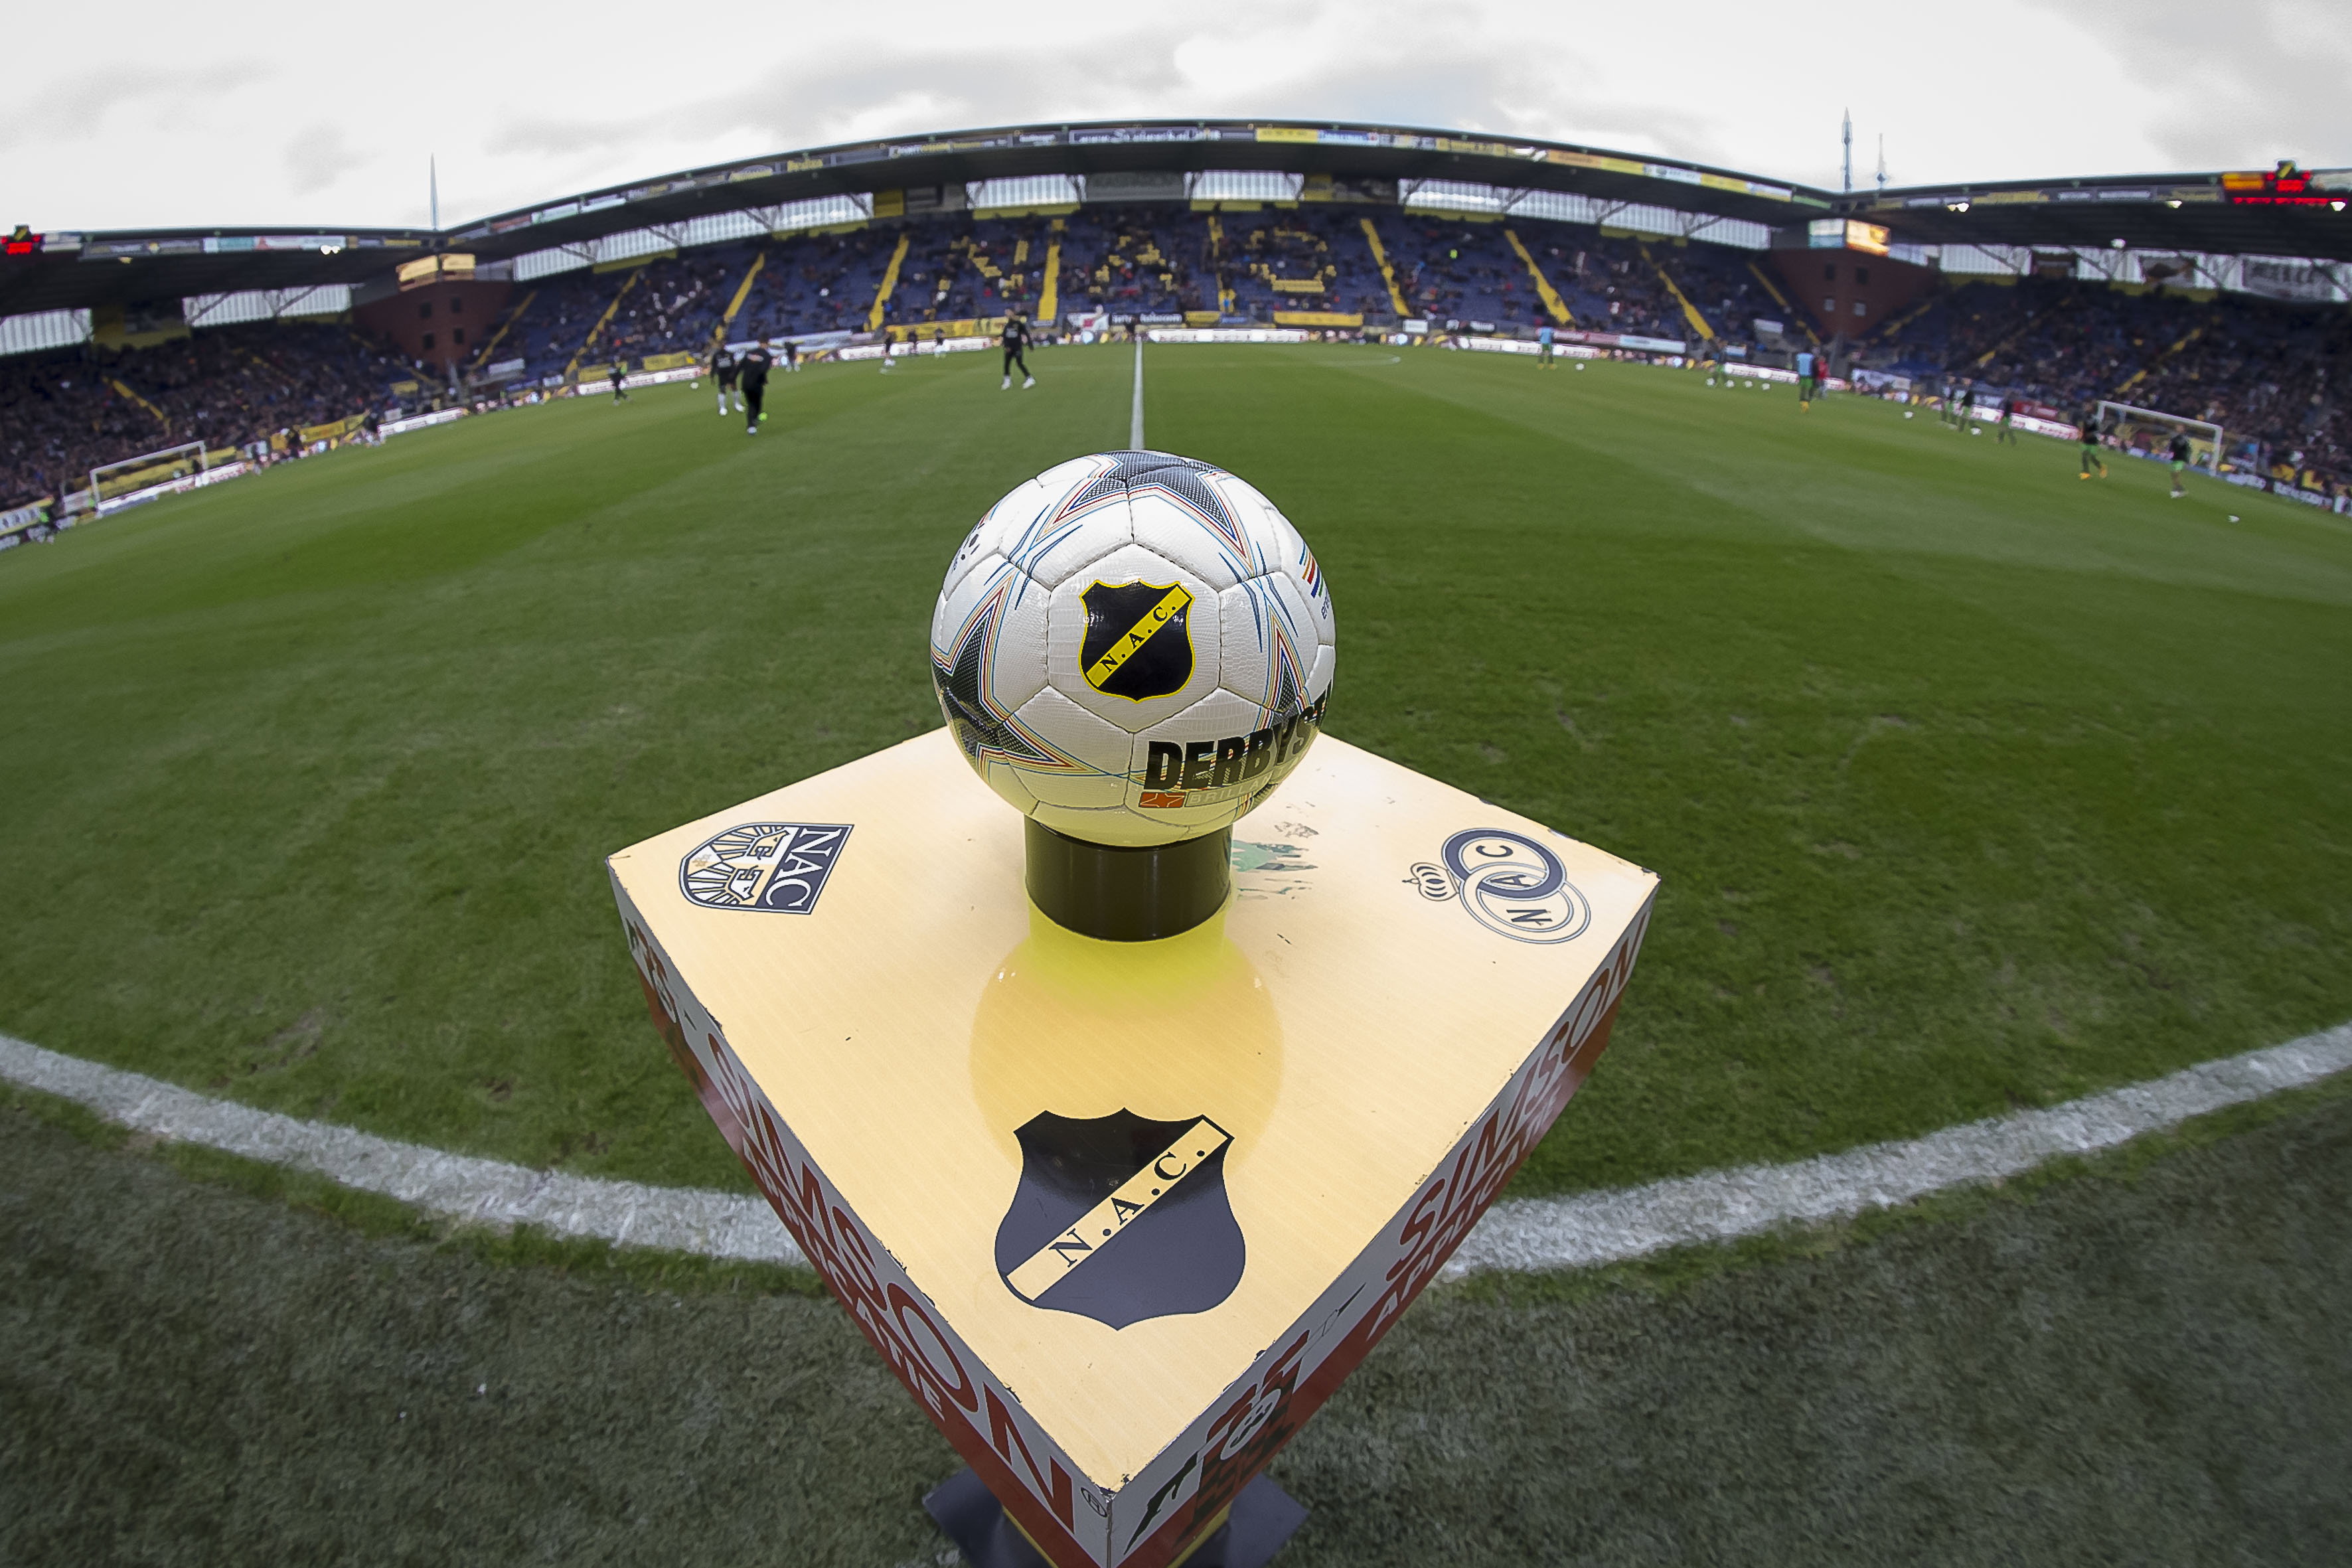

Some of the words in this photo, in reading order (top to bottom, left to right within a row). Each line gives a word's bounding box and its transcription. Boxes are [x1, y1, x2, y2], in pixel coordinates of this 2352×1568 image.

[1143, 678, 1332, 791] DERBYST
[765, 828, 842, 907] NAC
[1385, 911, 1647, 1283] SIMSON
[707, 1032, 1075, 1535] SIMSON
